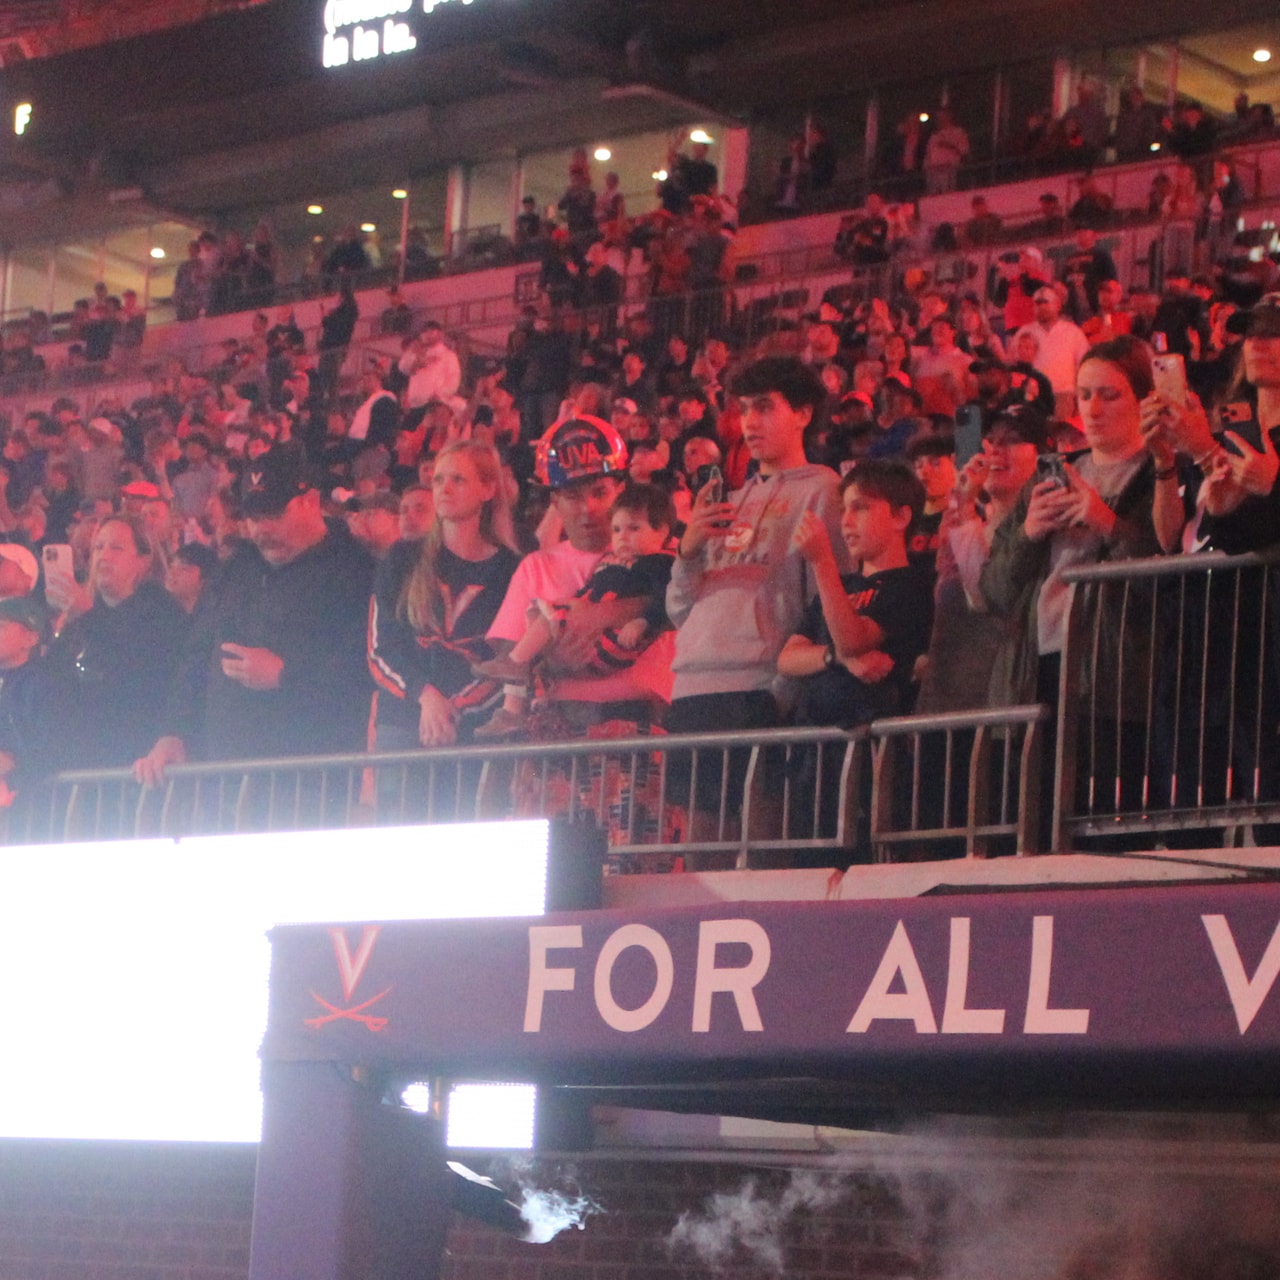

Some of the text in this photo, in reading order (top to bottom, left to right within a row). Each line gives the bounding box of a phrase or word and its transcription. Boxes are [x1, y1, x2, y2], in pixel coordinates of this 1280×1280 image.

[15, 103, 33, 135] F
[523, 918, 771, 1034] FOR
[846, 915, 1090, 1035] ALL
